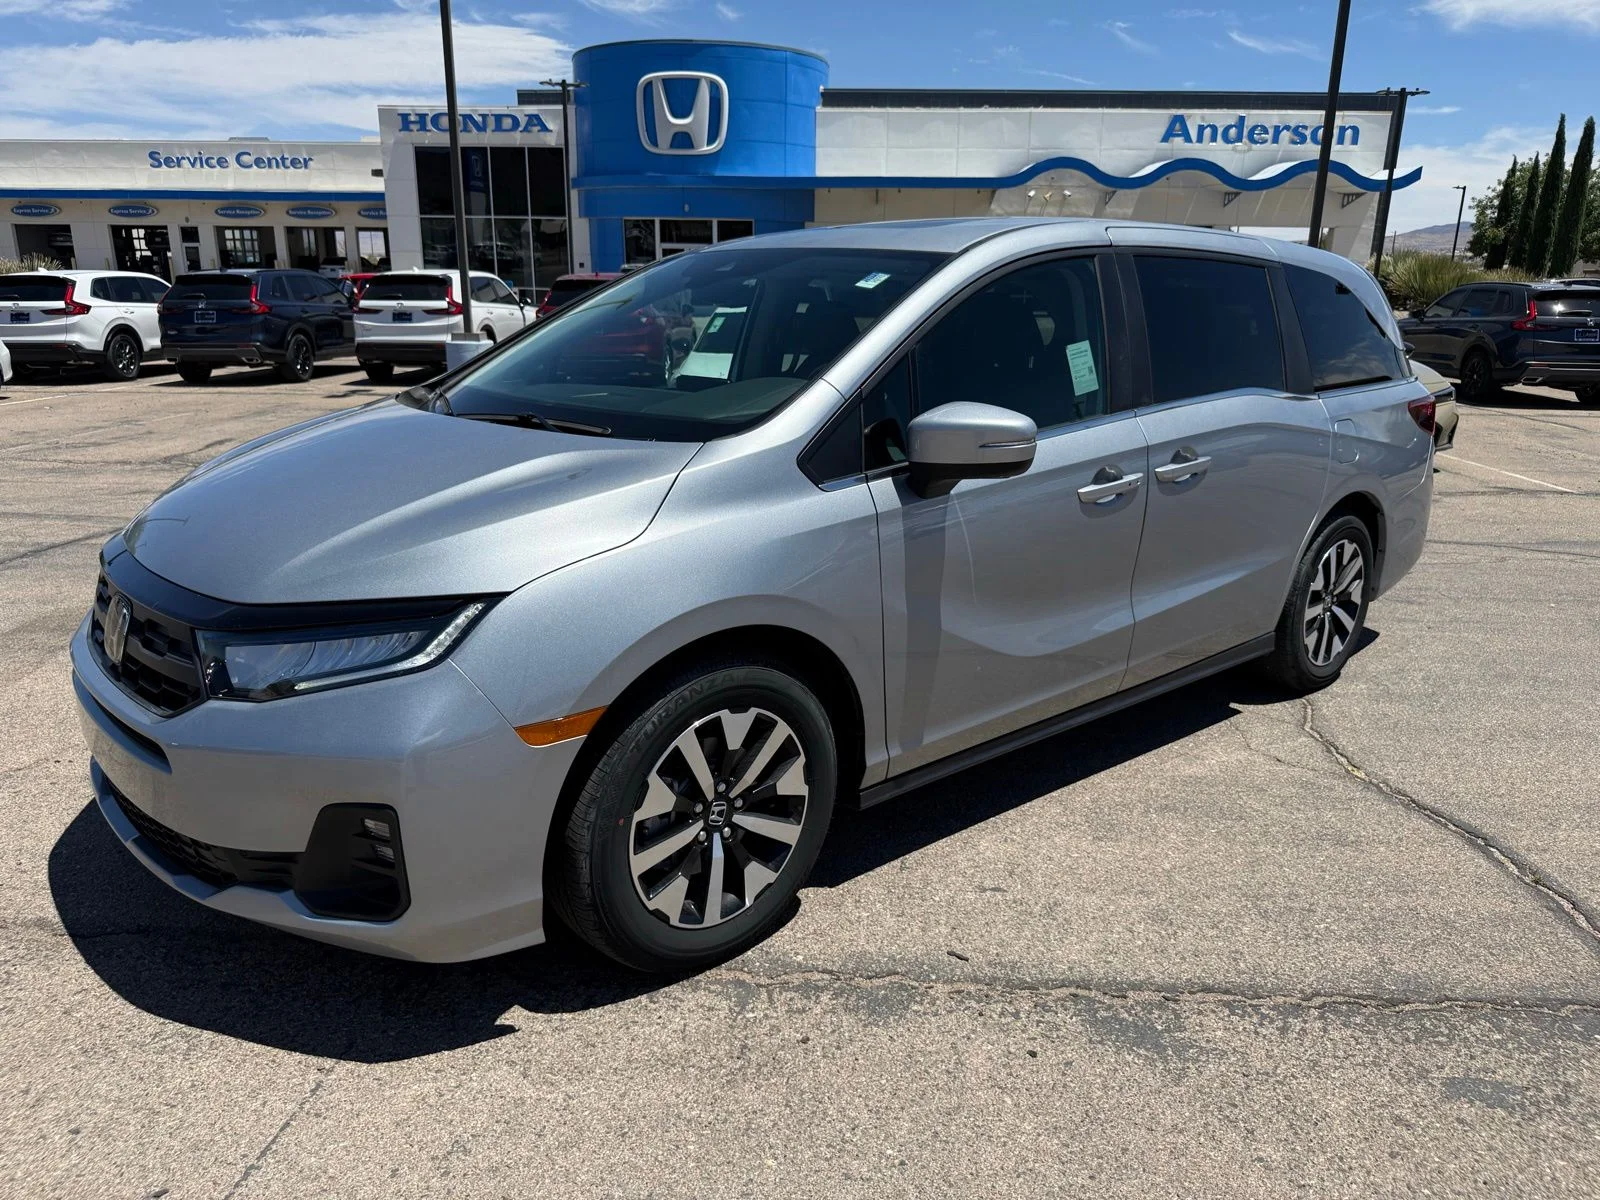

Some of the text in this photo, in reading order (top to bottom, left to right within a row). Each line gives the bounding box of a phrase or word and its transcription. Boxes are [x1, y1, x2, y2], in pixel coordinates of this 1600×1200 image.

[397, 112, 553, 134] HONDA
[1159, 113, 1361, 146] Anderson
[147, 151, 314, 171] Service Center
